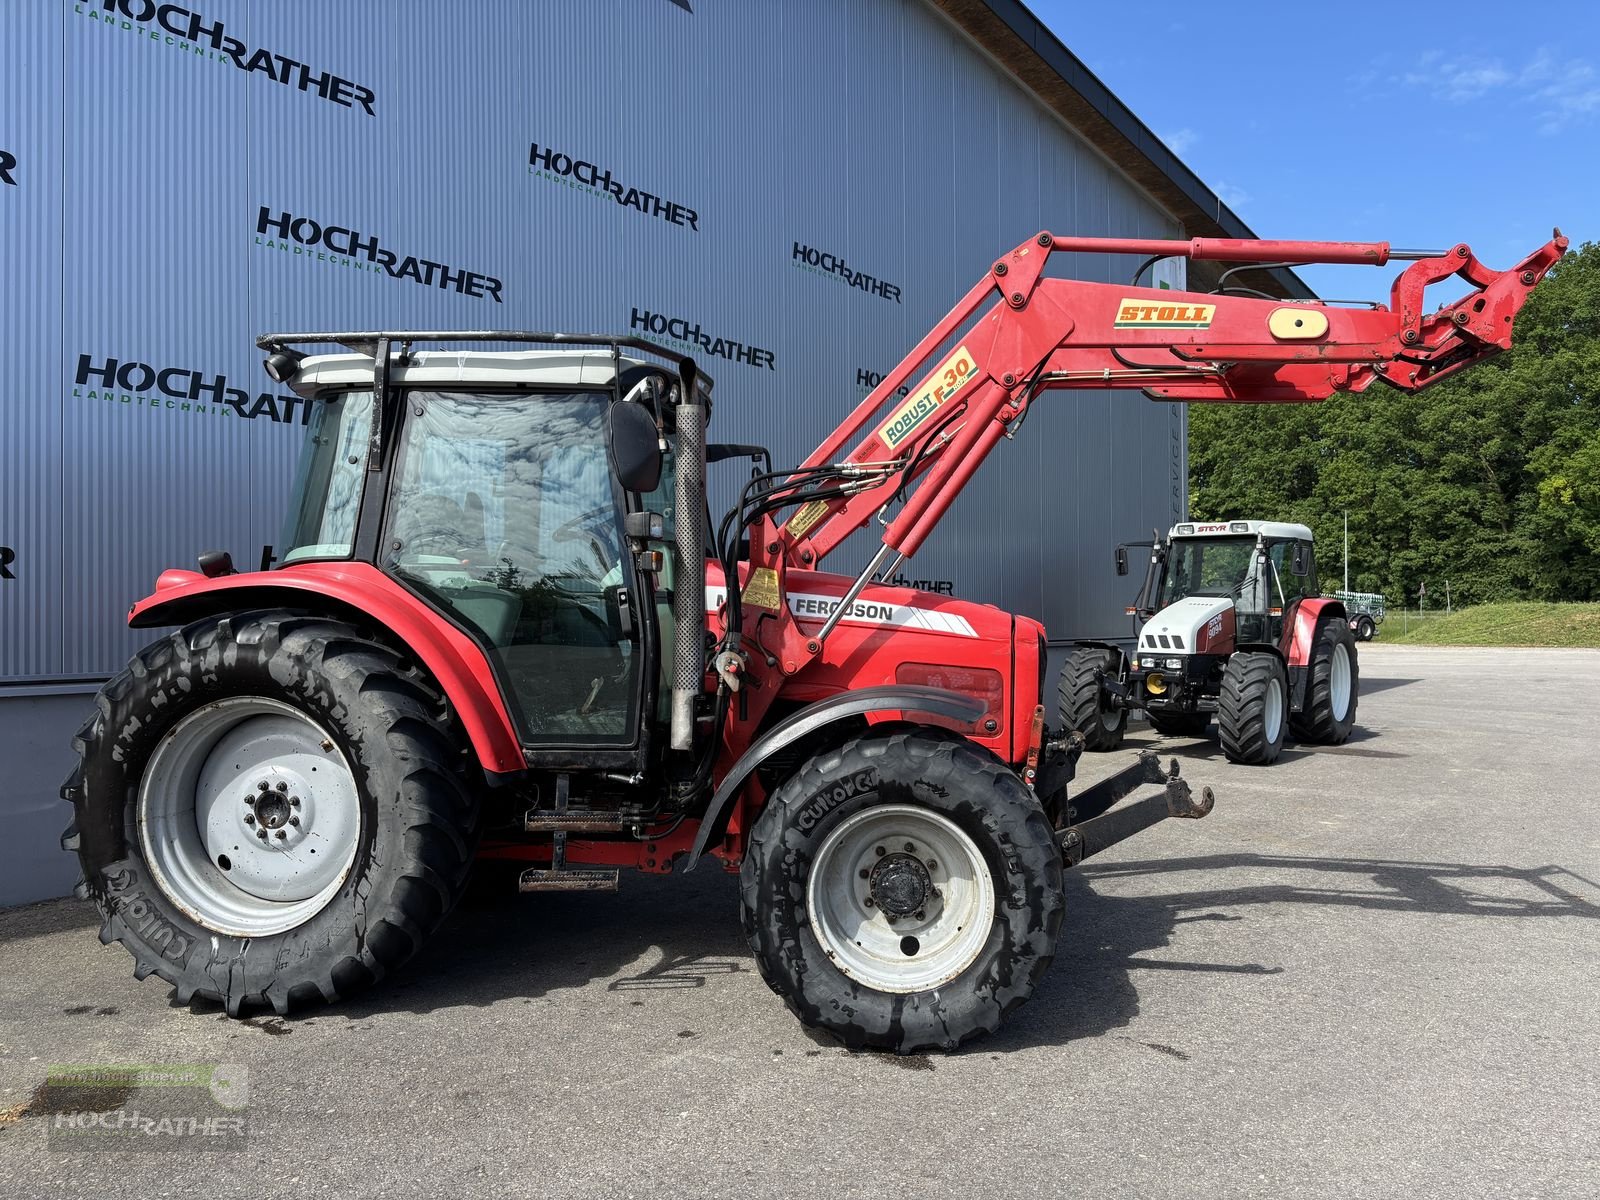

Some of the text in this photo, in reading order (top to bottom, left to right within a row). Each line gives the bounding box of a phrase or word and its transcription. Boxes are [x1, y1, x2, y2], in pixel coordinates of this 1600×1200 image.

[74, 4, 228, 64] LANDTECHNIK
[79, 0, 376, 117] OCHRATHER
[528, 167, 613, 201] LANDTECHNIK
[529, 142, 698, 232] HOCHRATHER
[255, 236, 381, 275] LANDTECHNIK
[256, 206, 503, 304] HOCHRATHER
[793, 241, 902, 305] HOCHRATHER
[630, 307, 775, 371] HOCHRATHER
[1120, 306, 1208, 322] STOLL
[73, 388, 230, 417] LANDTECHNIK
[885, 393, 933, 441] ROBUST
[933, 385, 946, 405] F
[944, 358, 970, 388] 30
